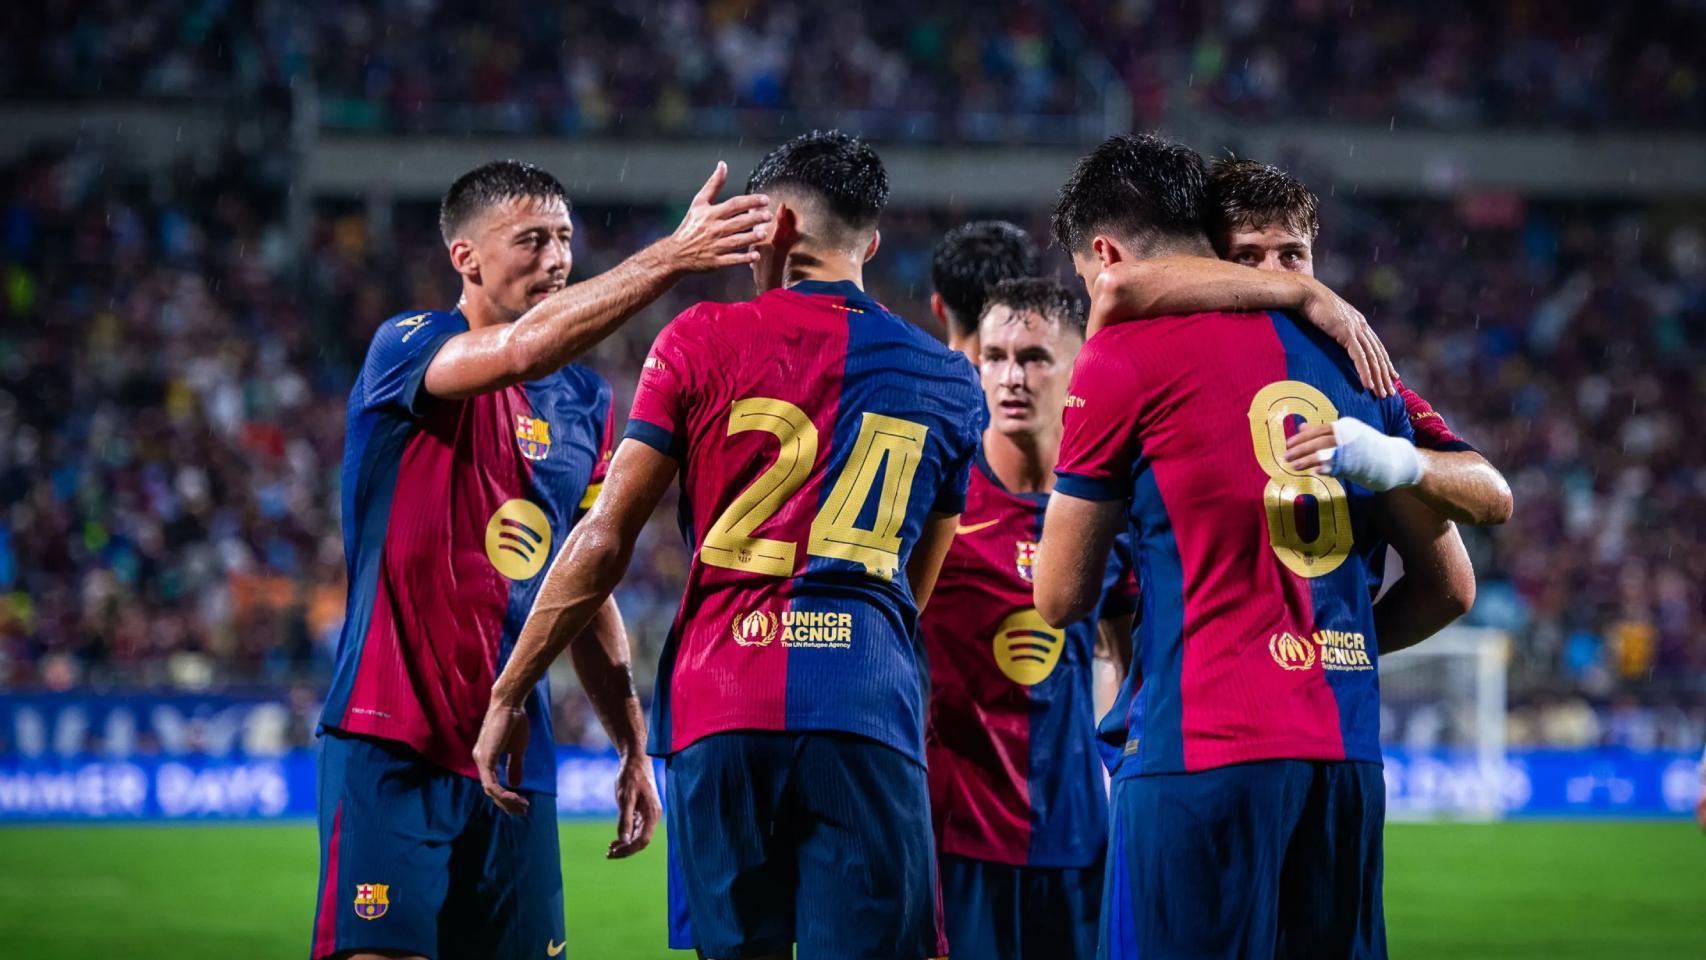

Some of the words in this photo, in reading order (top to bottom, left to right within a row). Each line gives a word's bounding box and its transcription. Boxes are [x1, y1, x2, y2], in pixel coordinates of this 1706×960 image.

[1247, 380, 1354, 578] 8
[700, 397, 929, 582] 24
[781, 611, 852, 627] UNHCR
[780, 627, 851, 642] ACNUR
[1312, 629, 1365, 650] UNHCR
[1320, 646, 1371, 665] ACNUR
